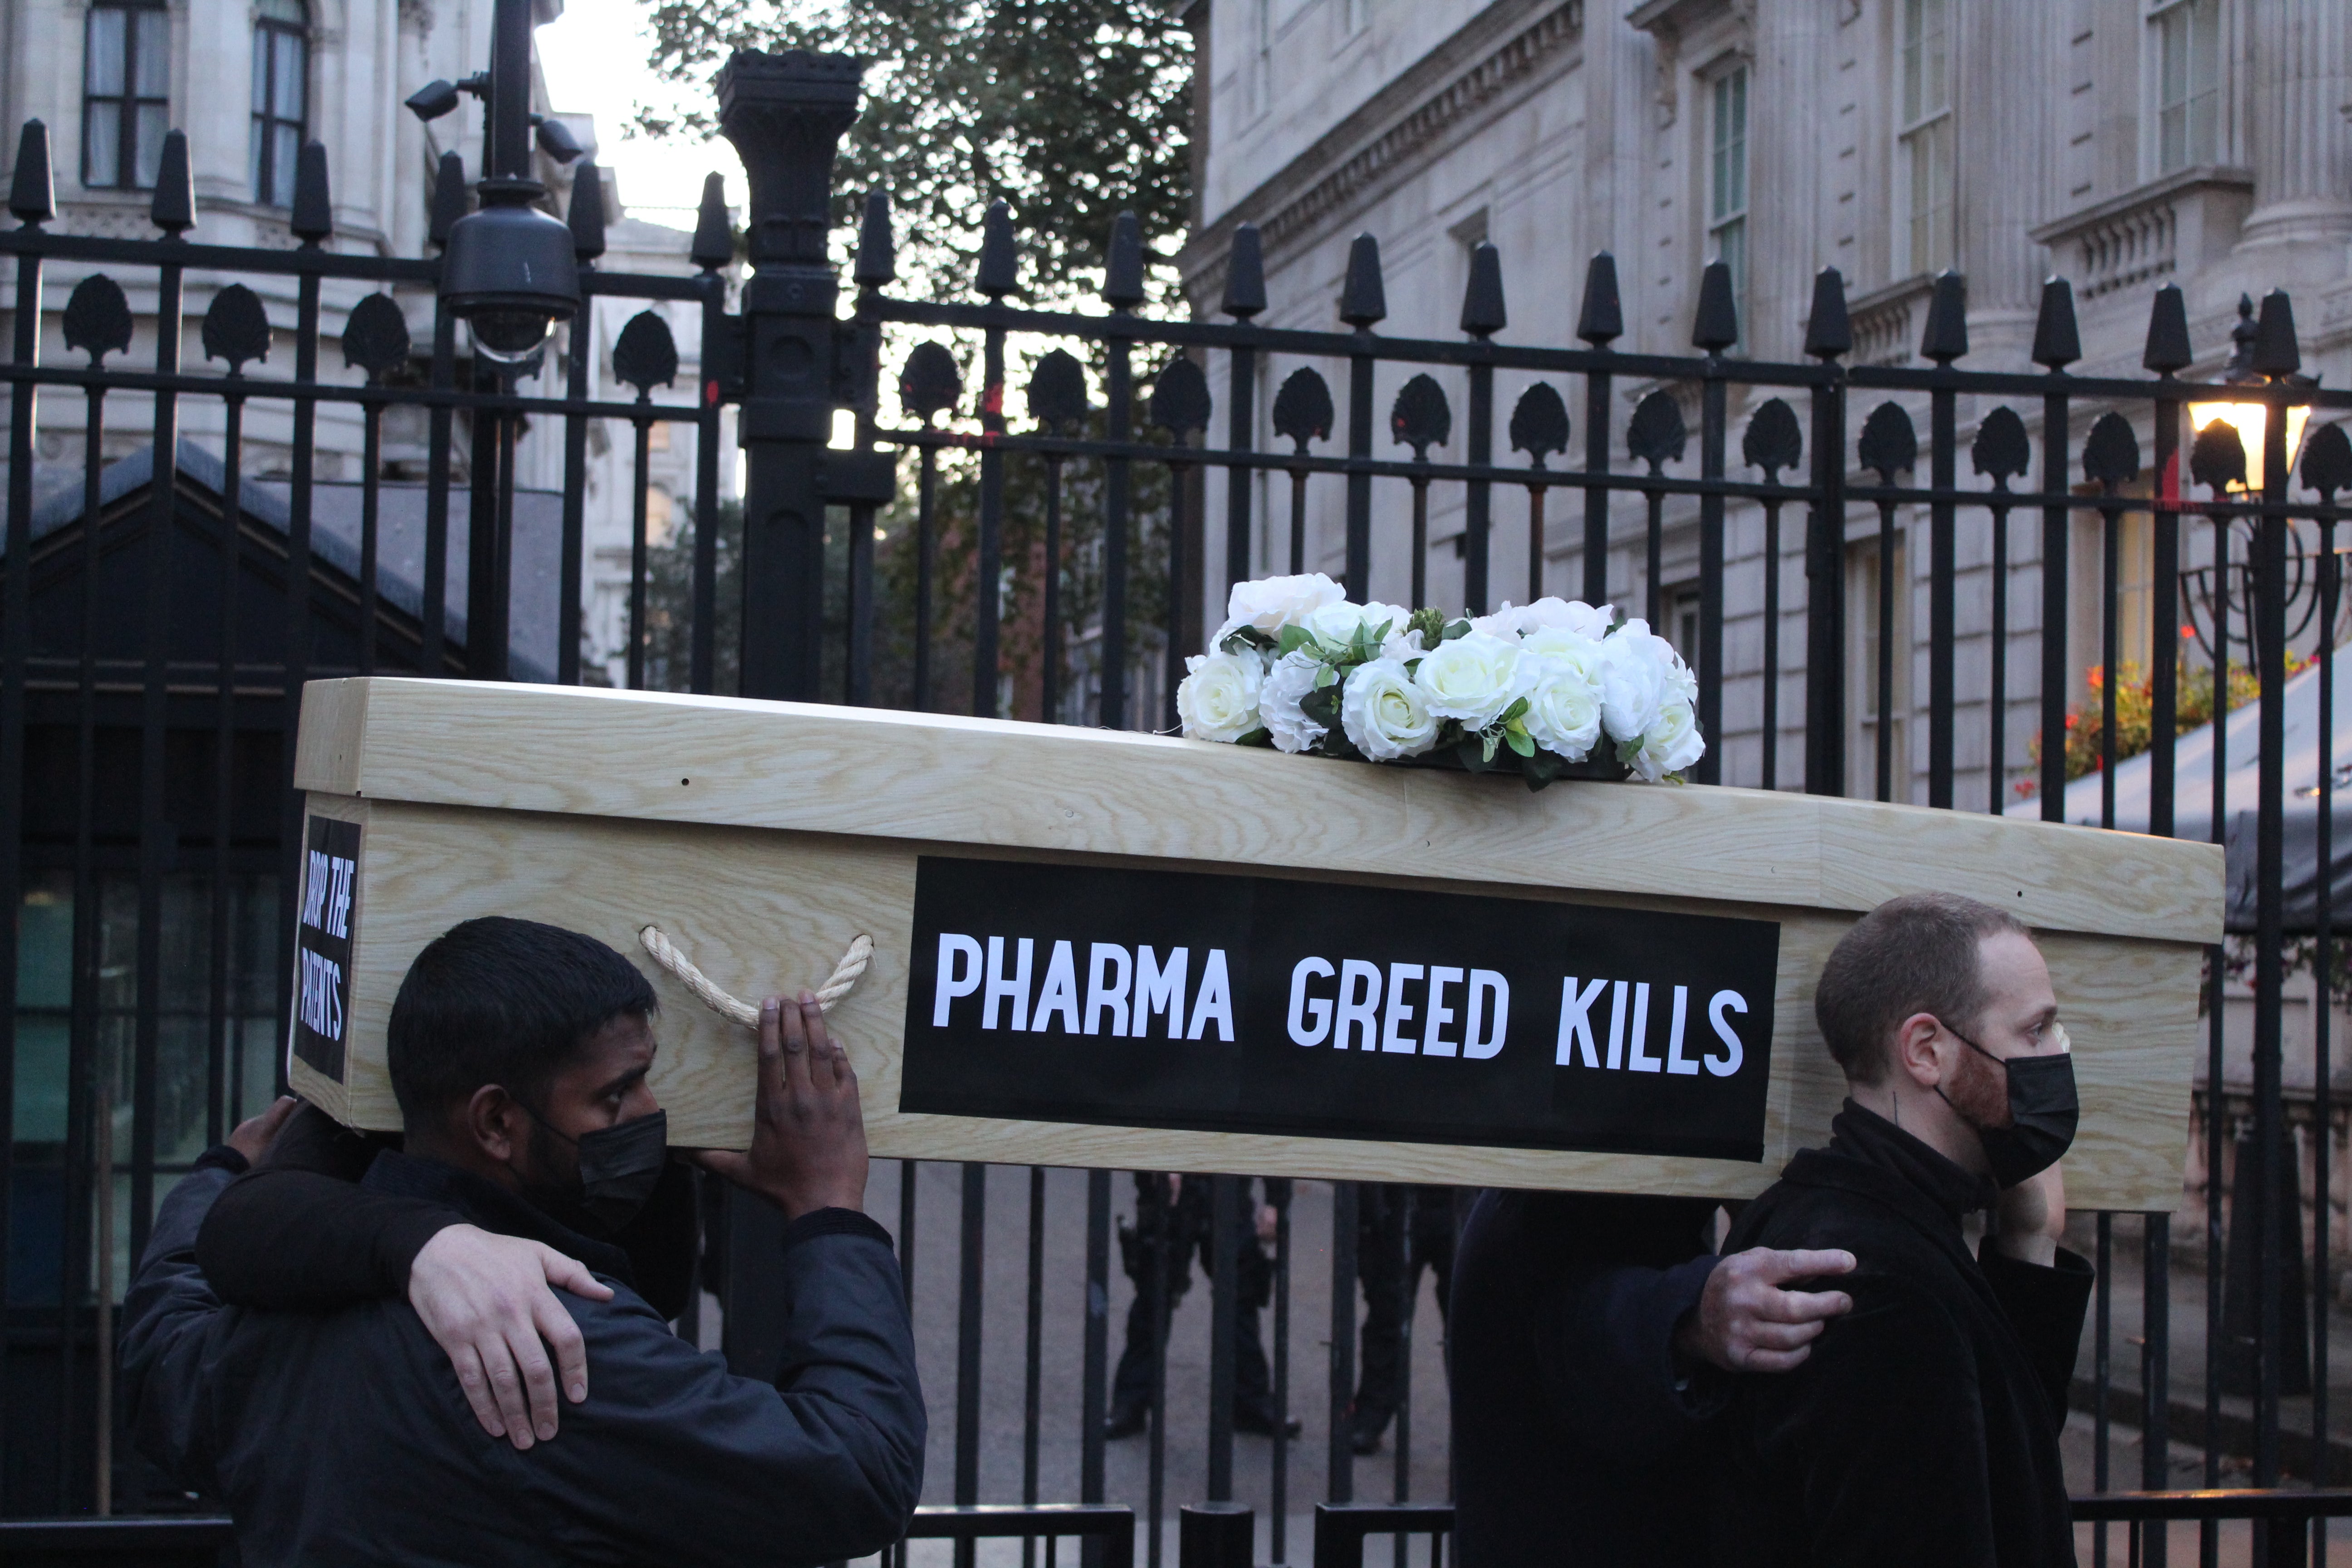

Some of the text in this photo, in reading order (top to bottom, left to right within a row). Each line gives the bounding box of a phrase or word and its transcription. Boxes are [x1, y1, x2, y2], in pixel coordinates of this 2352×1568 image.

[303, 850, 354, 939] DROP THE
[301, 947, 342, 1041] PATENTS
[933, 933, 1748, 1077] PHARMA GREED KILLS
